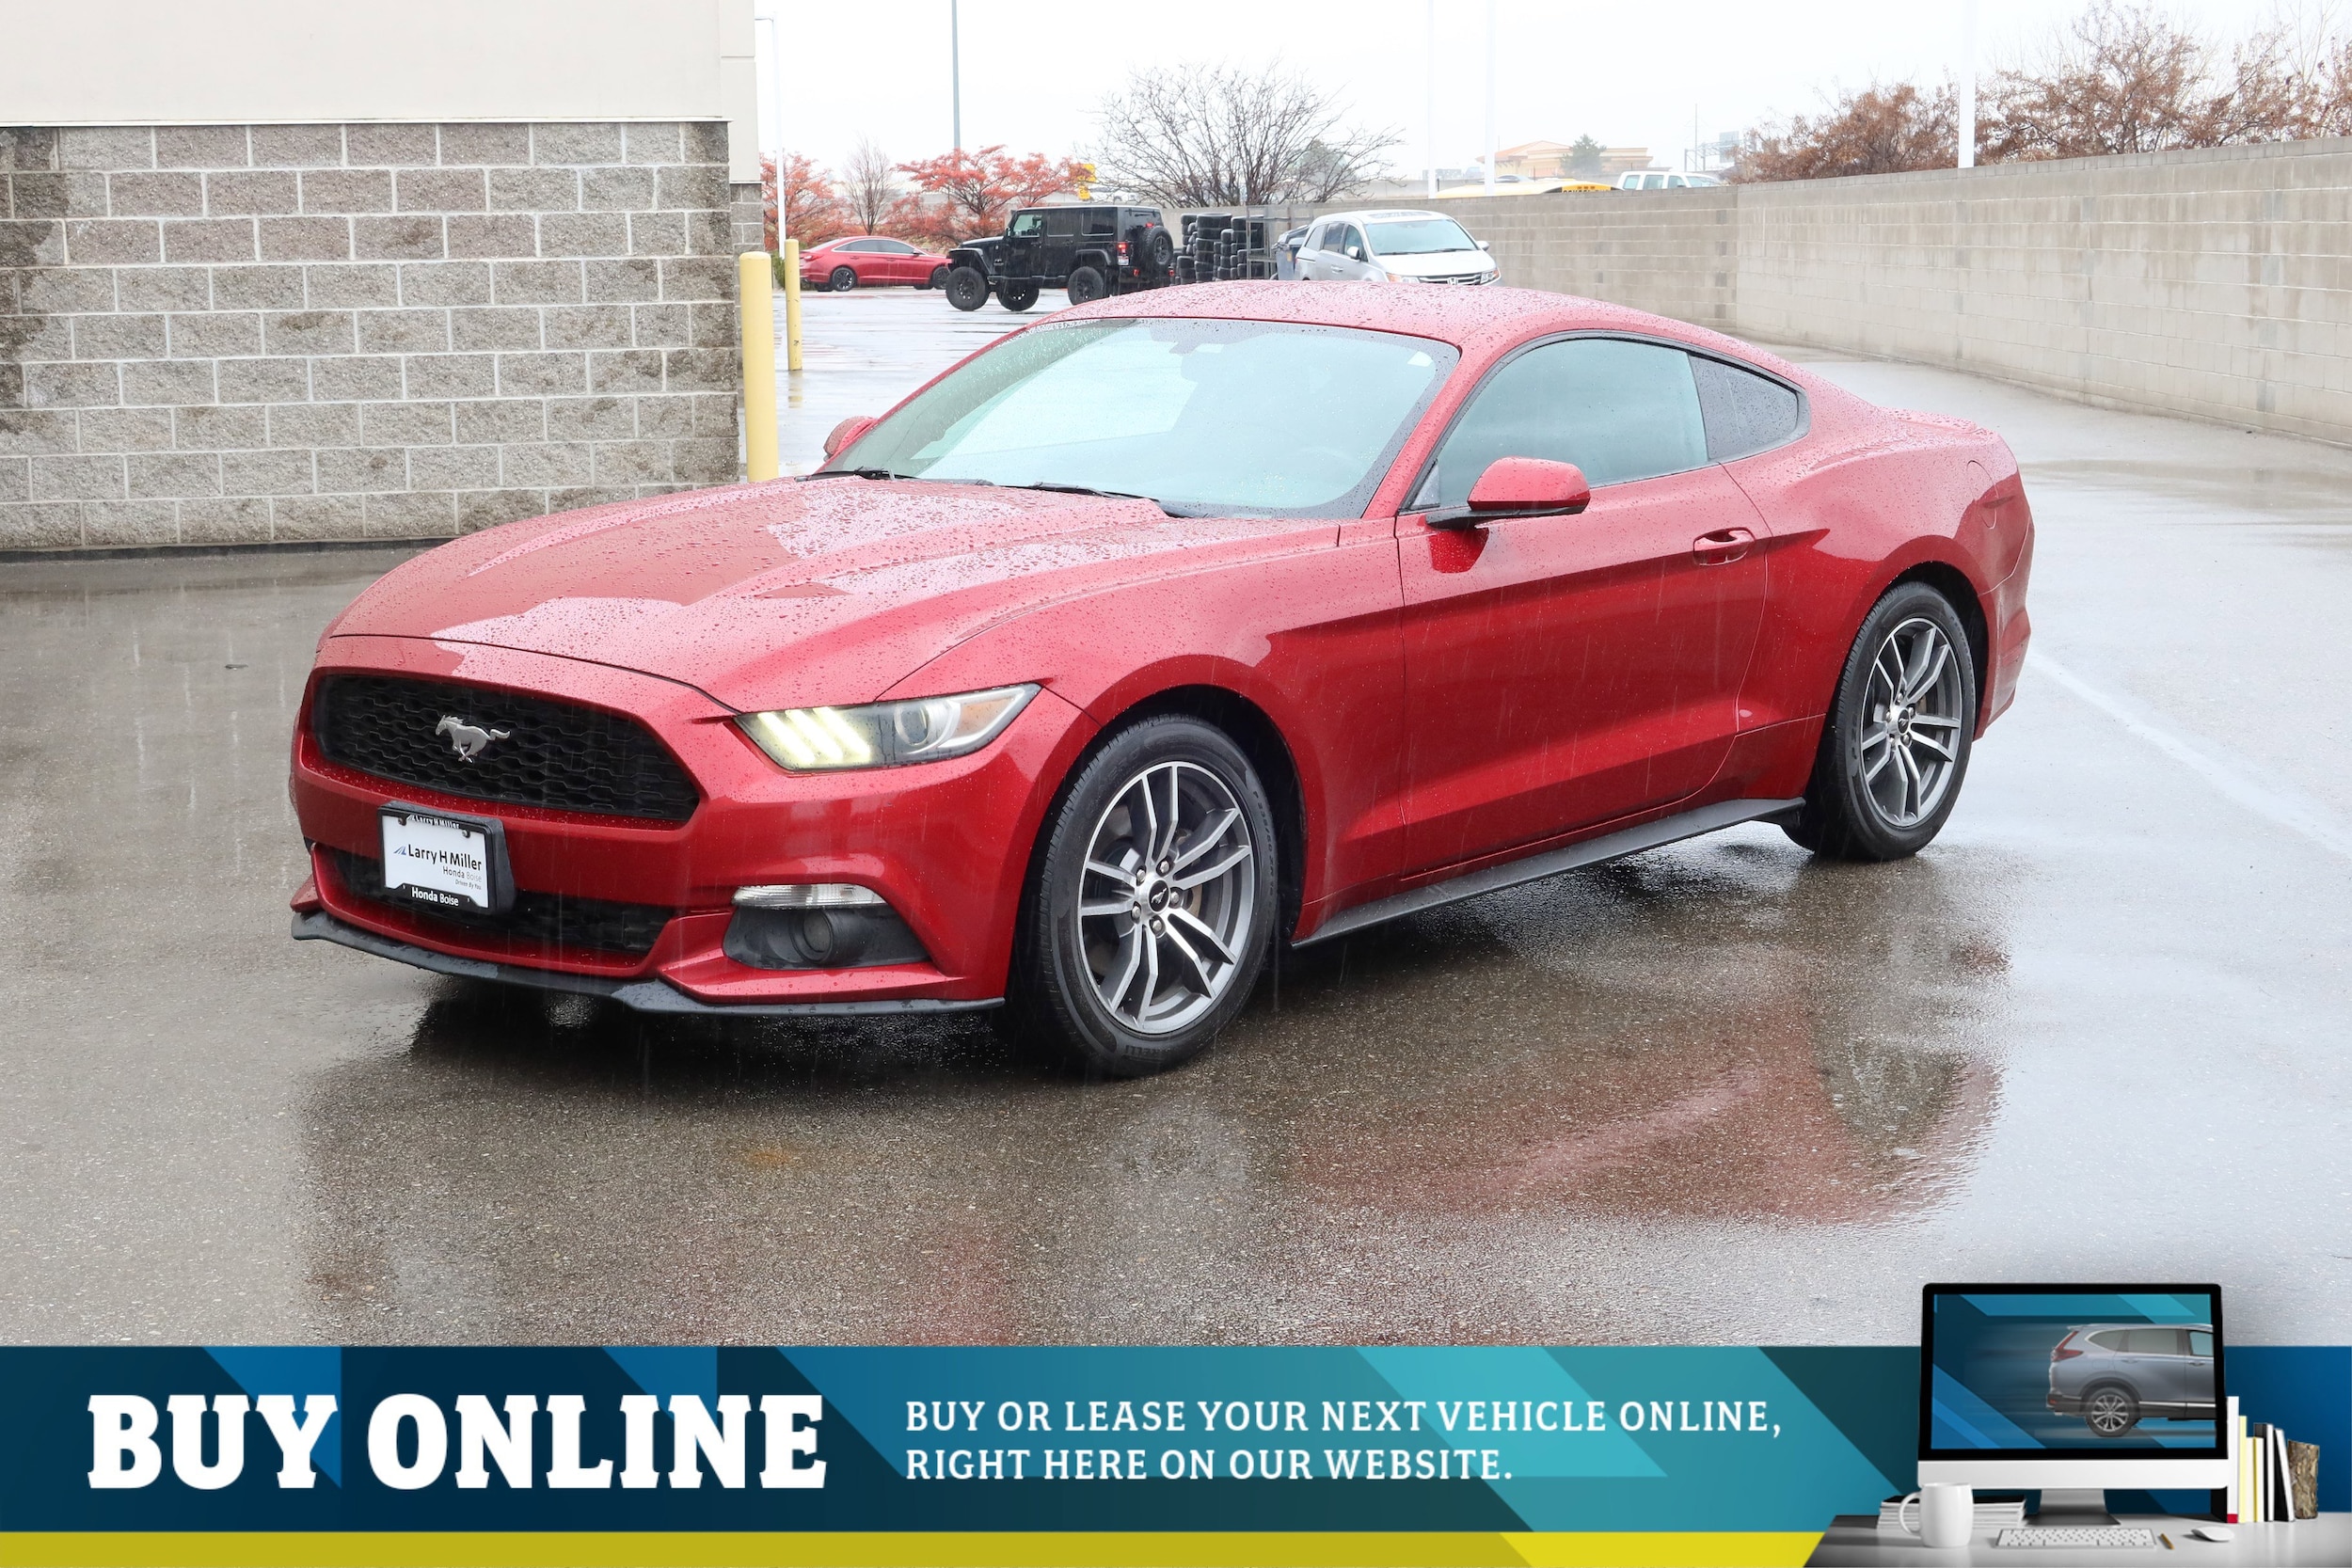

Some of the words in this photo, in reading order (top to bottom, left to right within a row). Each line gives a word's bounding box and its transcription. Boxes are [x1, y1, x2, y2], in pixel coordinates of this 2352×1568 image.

[415, 815, 433, 826] Larry
[439, 819, 459, 830] Miller
[408, 844, 437, 864] Larry
[439, 850, 448, 863] H
[450, 852, 482, 871] Miller
[443, 865, 465, 879] Honda
[466, 873, 482, 882] Boise
[469, 881, 474, 890] By
[411, 887, 438, 902] Honda
[439, 893, 459, 906] Boise
